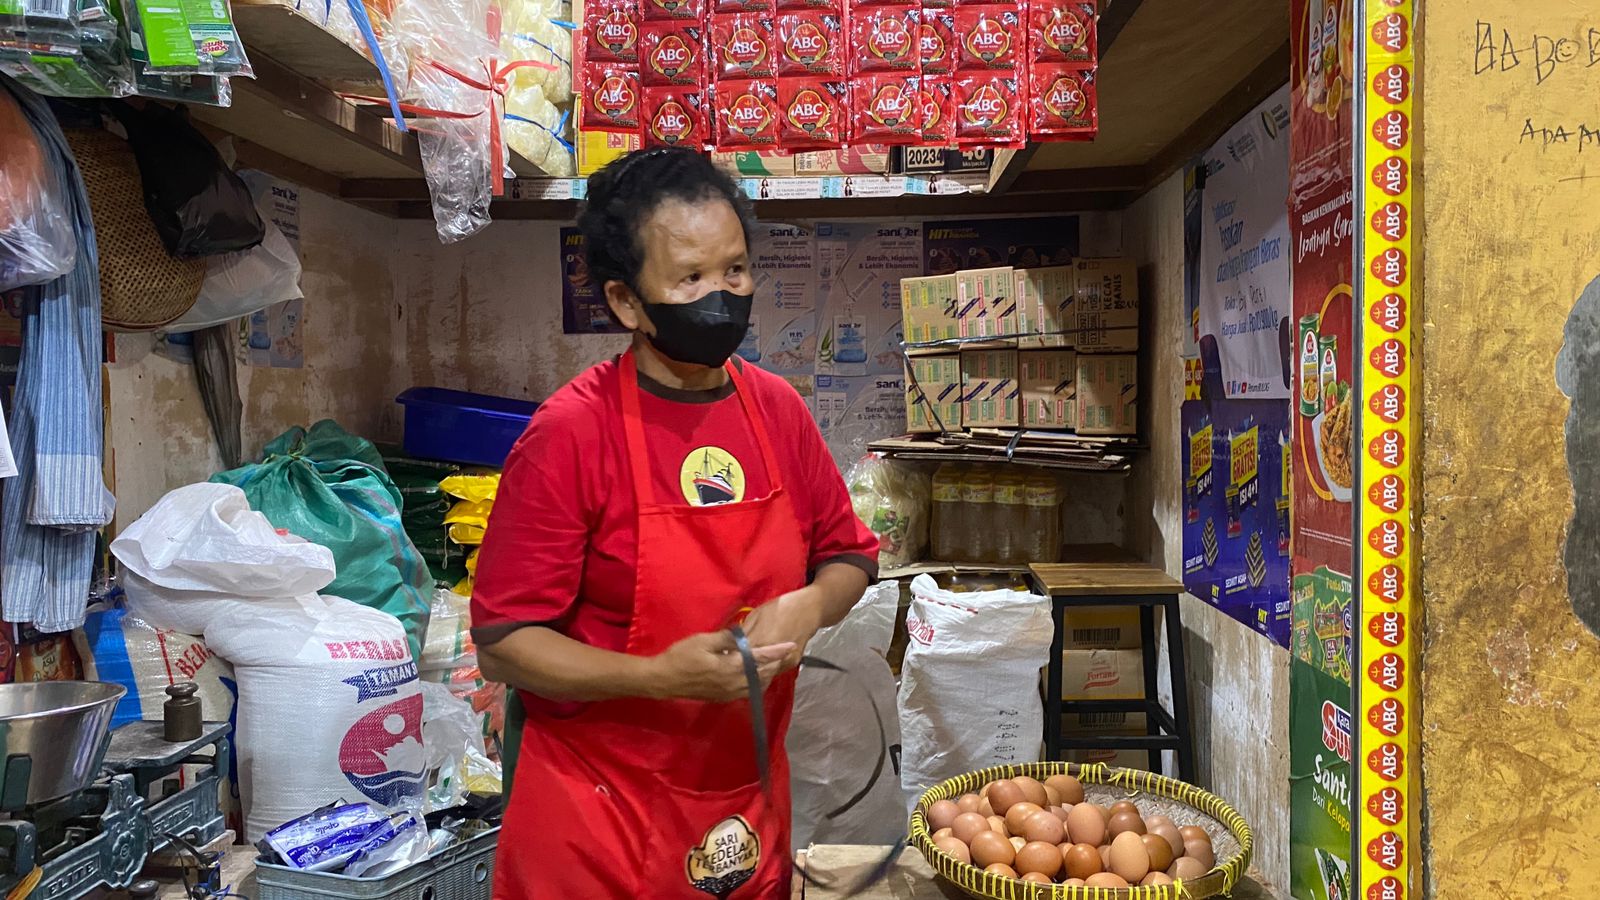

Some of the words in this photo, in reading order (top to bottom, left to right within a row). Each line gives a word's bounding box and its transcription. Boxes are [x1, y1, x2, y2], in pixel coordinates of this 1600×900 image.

[792, 36, 820, 49] ABC
[875, 32, 904, 44] ABC
[921, 38, 937, 49] BC
[973, 32, 1002, 44] ABC
[1051, 24, 1080, 37] ABC
[1387, 15, 1400, 49] ABC
[657, 49, 685, 61] ABC
[1052, 91, 1079, 102] ABC
[1388, 67, 1402, 101] ABC
[658, 115, 686, 128] ABC
[734, 107, 762, 120] ABC
[794, 104, 822, 116] ABC
[1388, 113, 1401, 147] ABC
[1387, 159, 1400, 192] ABC
[1386, 204, 1400, 238] ABC
[1386, 250, 1400, 284] ABC
[1103, 275, 1112, 310] KECAP
[1385, 296, 1399, 329] ABC
[1385, 341, 1399, 375] ABC
[1384, 387, 1398, 420] ABC
[1384, 432, 1398, 466] ABC
[1383, 477, 1398, 510] ABC
[1383, 522, 1397, 555] ABC
[1383, 567, 1397, 600] ABC
[1384, 612, 1397, 644] ABC
[1383, 656, 1397, 688] ABC
[1383, 700, 1397, 733] ABC
[1383, 745, 1397, 778] ABC
[1312, 787, 1325, 809] Dari
[1327, 799, 1350, 832] Kelapa
[1383, 790, 1397, 823] ABC
[715, 833, 738, 849] SARI
[1383, 834, 1396, 867] ABC
[1382, 879, 1396, 900] BC
